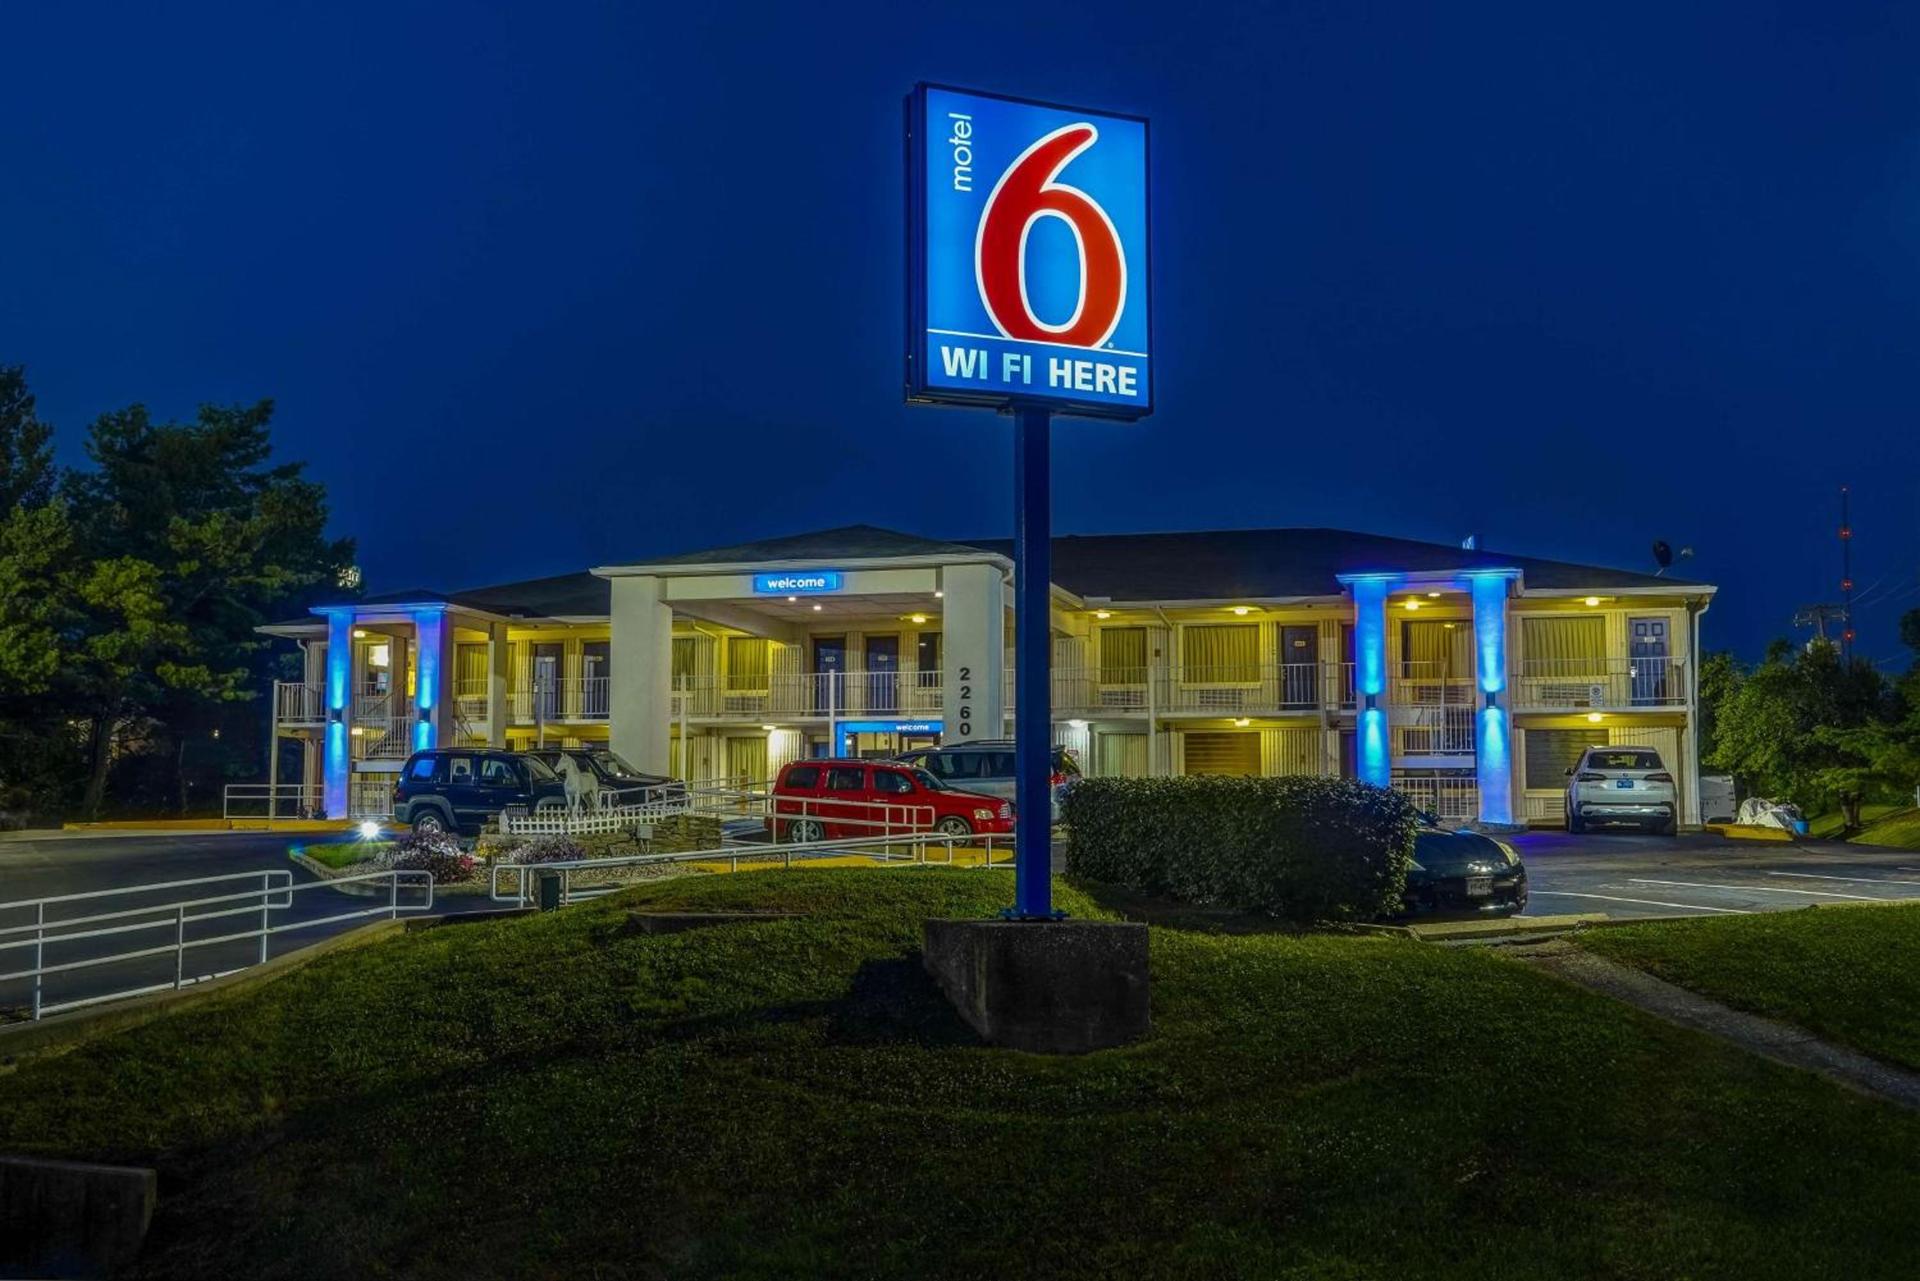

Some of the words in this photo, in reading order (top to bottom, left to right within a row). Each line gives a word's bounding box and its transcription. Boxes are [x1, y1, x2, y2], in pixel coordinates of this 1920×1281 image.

[949, 113, 972, 192] motel
[975, 122, 1127, 349] 6
[941, 346, 988, 380] WI
[1002, 352, 1032, 384] FI
[1049, 357, 1138, 397] HERE
[767, 577, 826, 589] welcome
[896, 723, 930, 732] welcome
[959, 667, 971, 736] 2260
